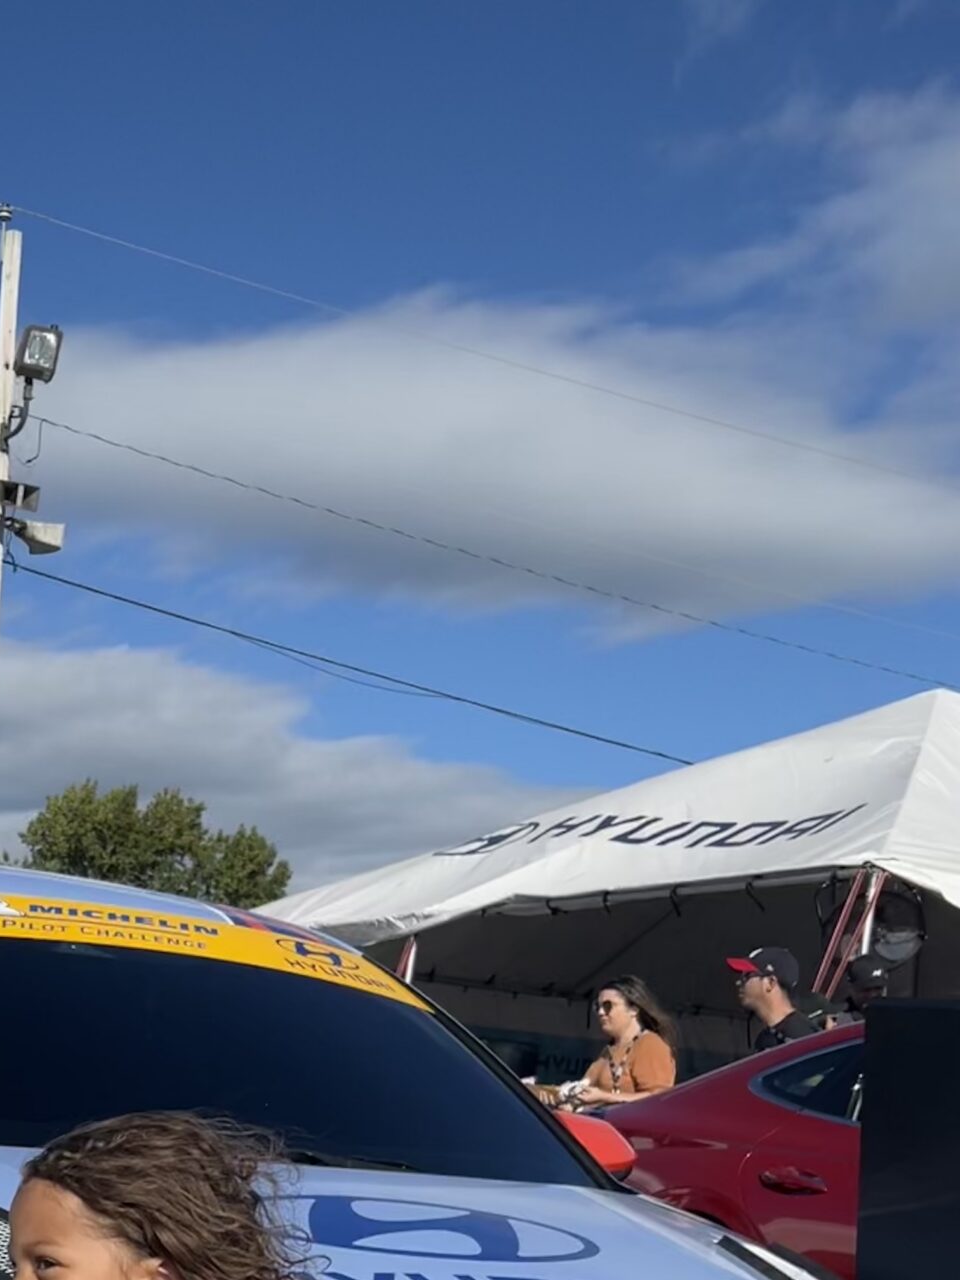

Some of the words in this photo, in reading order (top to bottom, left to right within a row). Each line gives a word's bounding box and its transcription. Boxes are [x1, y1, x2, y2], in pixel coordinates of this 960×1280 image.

[528, 802, 868, 848] HYUNDAI
[2, 918, 67, 934] PILOT
[80, 924, 207, 949] CHALLENGE
[28, 903, 219, 936] MICHELIN
[284, 957, 397, 993] HYUNDAI
